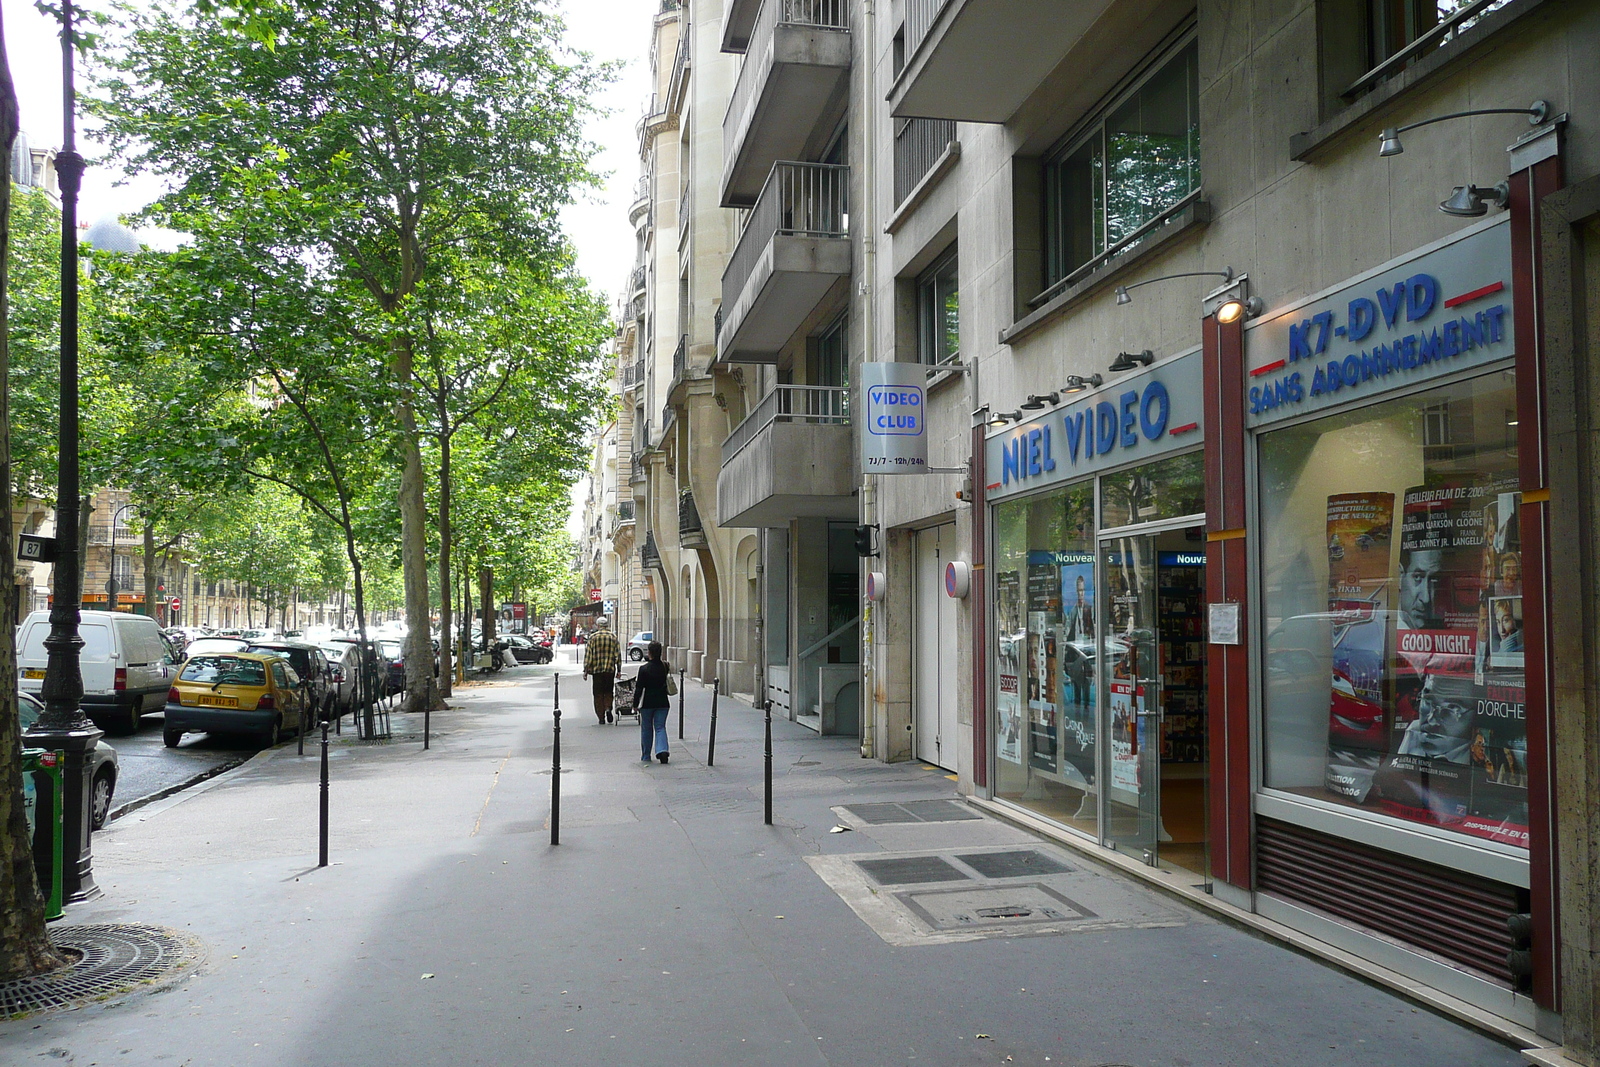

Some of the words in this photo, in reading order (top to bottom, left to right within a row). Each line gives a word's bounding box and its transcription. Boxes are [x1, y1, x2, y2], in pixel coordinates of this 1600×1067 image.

[1289, 273, 1437, 363] K7-DVD
[1249, 371, 1304, 414] SANS
[1310, 304, 1504, 397] ABONNEMENT
[872, 392, 920, 406] VIDEO
[877, 415, 916, 428] CLUB
[1003, 424, 1056, 485] NIEL
[1064, 381, 1170, 466] VIDEO
[894, 457, 925, 466] 12h/24h
[1408, 490, 1435, 503] MEILLEUR
[1435, 489, 1453, 501] FILM
[1454, 487, 1466, 498] DE
[1461, 510, 1482, 518] GEORGE
[1425, 519, 1453, 529] CLARKSON
[26, 543, 39, 555] 87
[1420, 538, 1440, 548] DOWNEY
[1402, 633, 1432, 651] GOOD
[1435, 634, 1472, 655] NIGHT,
[1000, 676, 1018, 689] SCOOP
[1064, 716, 1084, 733] CASINO
[1075, 730, 1095, 745] ROYALE
[1463, 821, 1508, 836] DISPONIBLE
[1509, 830, 1521, 838] EN
